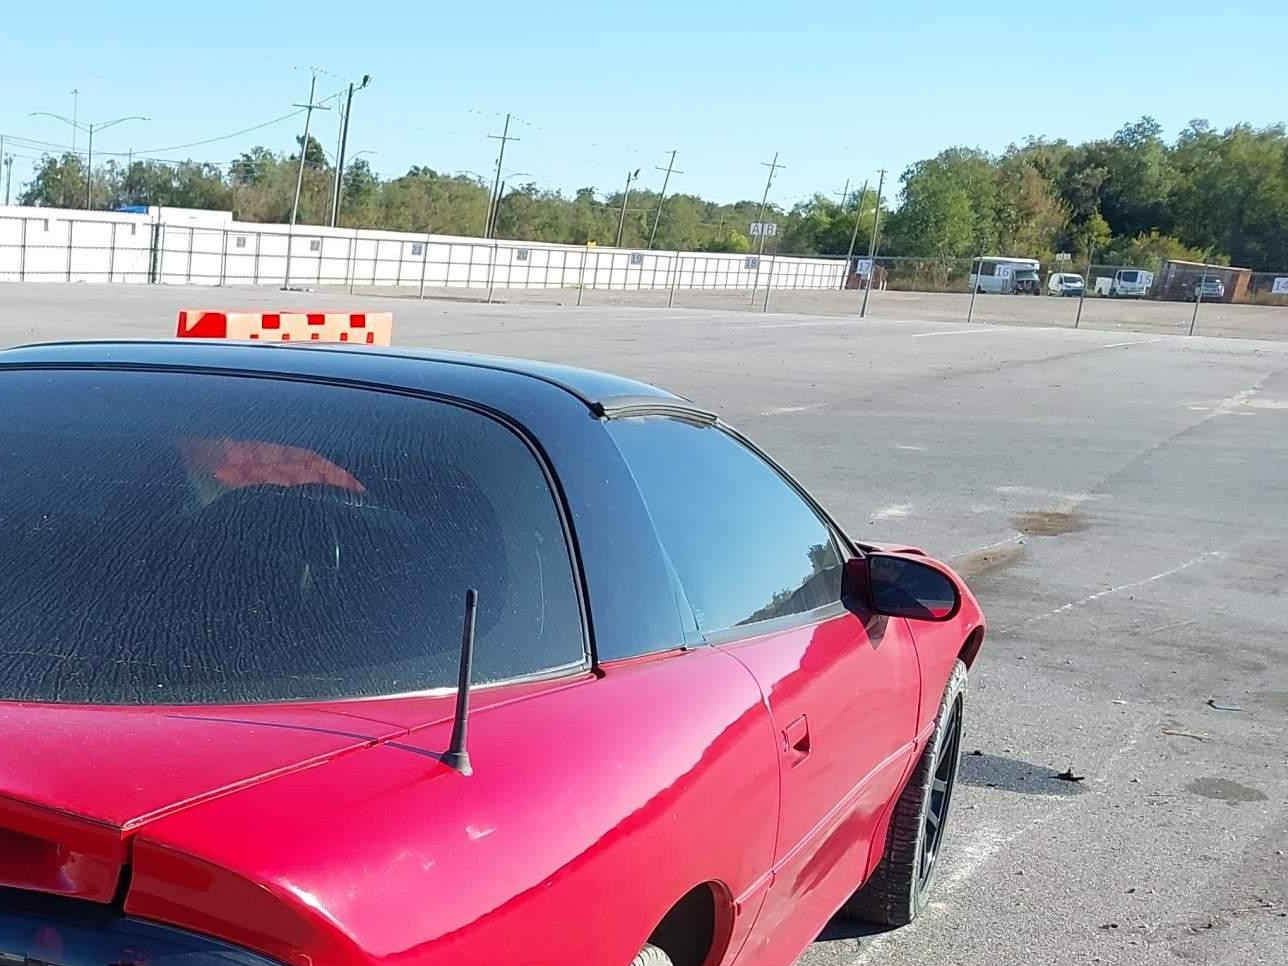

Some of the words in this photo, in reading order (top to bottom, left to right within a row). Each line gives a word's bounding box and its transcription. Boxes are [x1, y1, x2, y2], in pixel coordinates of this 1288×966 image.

[752, 223, 760, 234] A
[766, 224, 774, 235] B
[746, 258, 757, 268] 18
[858, 262, 871, 272] 17
[996, 266, 1009, 277] 16
[1138, 274, 1151, 285] 15
